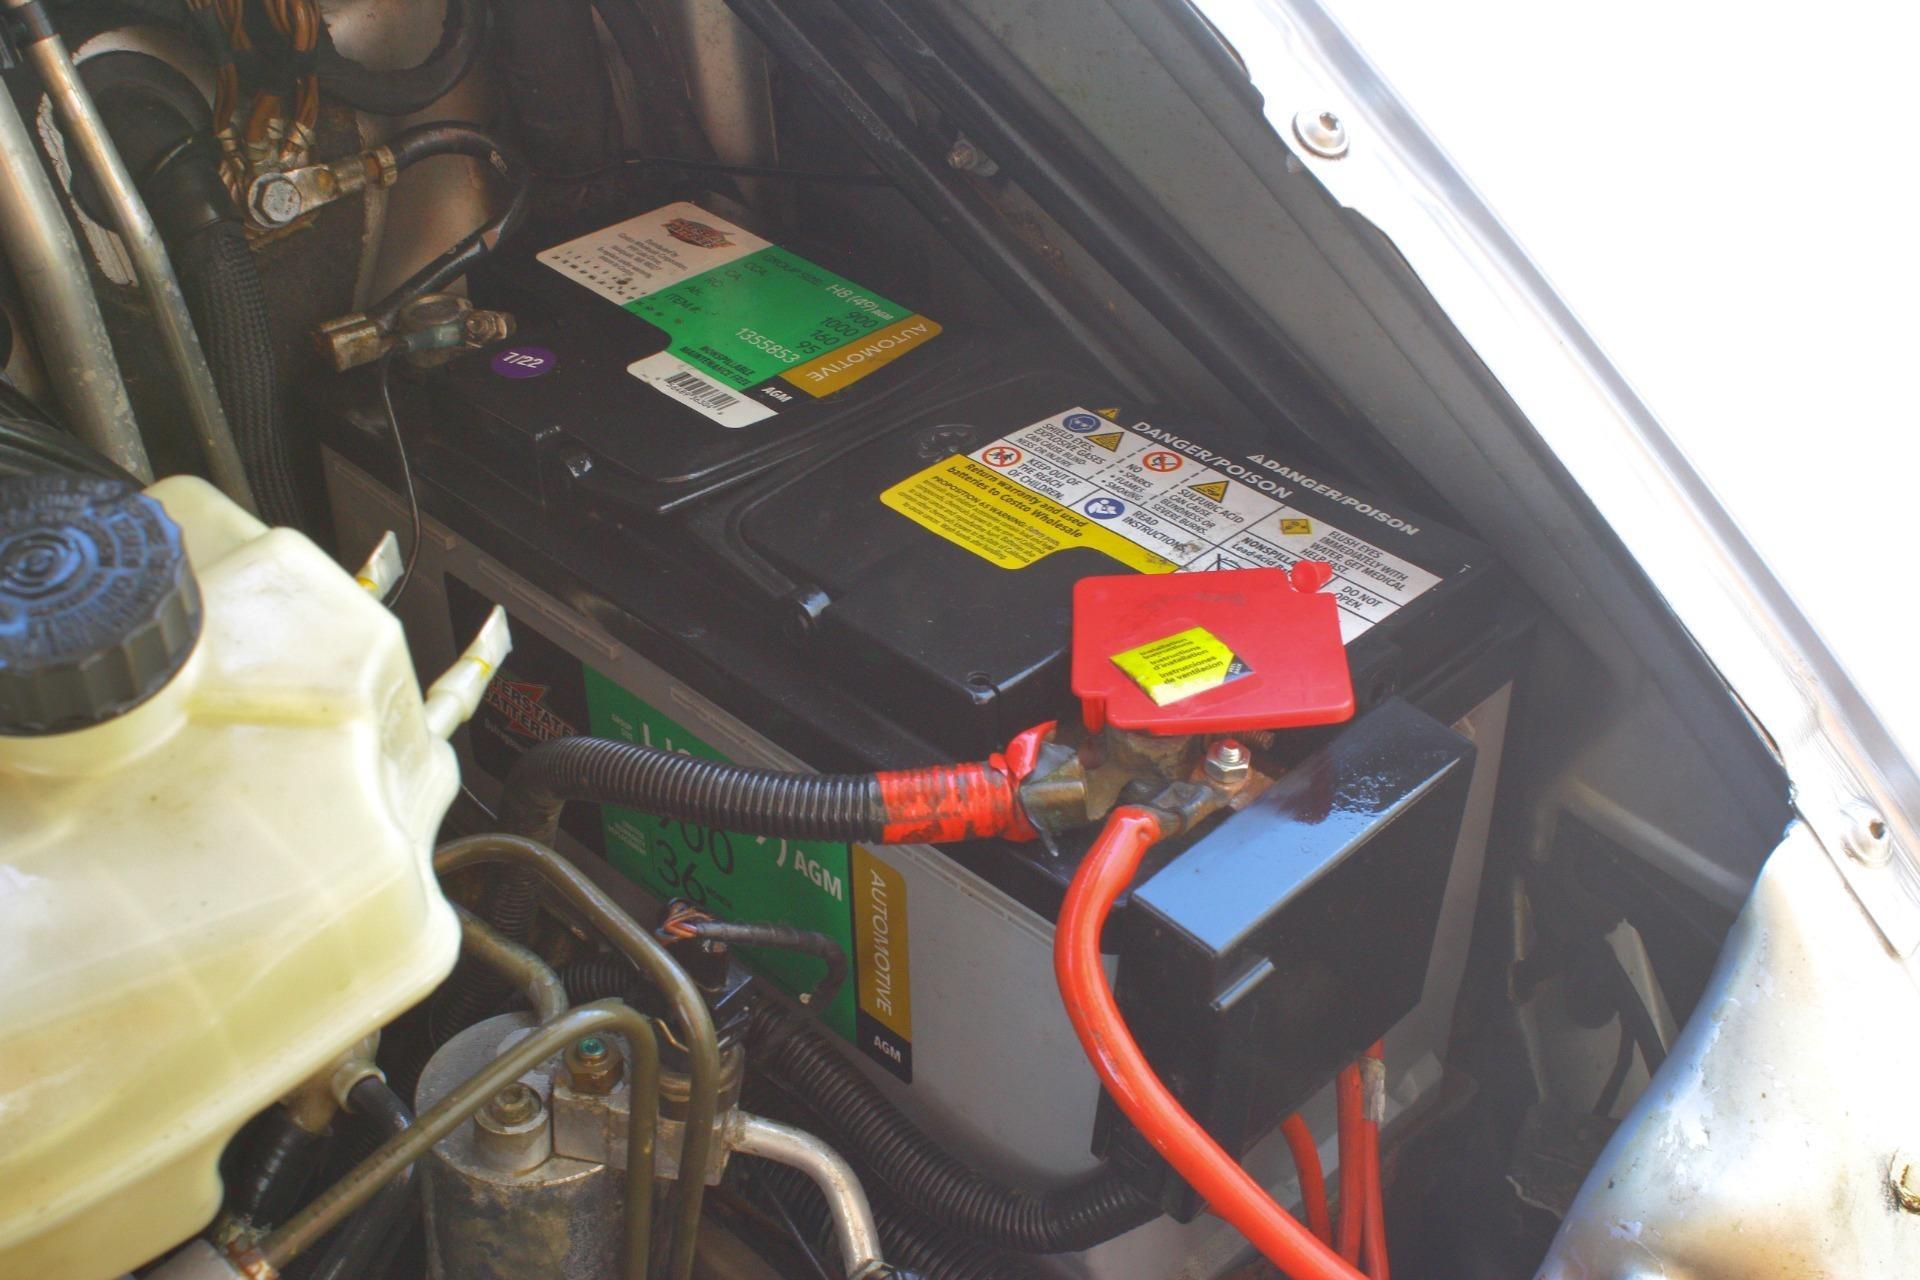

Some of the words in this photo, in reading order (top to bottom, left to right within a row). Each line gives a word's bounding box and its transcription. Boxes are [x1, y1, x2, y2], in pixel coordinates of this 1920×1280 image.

[826, 284, 853, 298] H8
[846, 294, 880, 312] (49)
[820, 317, 859, 337] 1000
[846, 311, 879, 328] 900
[736, 328, 801, 363] 1355853
[796, 340, 821, 354] 95
[811, 330, 840, 346] 160
[503, 352, 545, 369] 7/22
[700, 345, 756, 376] NONSPILLABLE
[806, 323, 928, 382] AUTOMOTIVE
[761, 386, 793, 403] AGM
[1025, 433, 1043, 444] CAN
[1040, 440, 1064, 455] CAUSE
[1042, 423, 1074, 440] SHIELD
[1016, 438, 1036, 450] NESS
[1034, 446, 1046, 455] OR
[1034, 428, 1077, 452] EXPLOSIVE
[1076, 449, 1107, 465] GASES
[1132, 421, 1294, 500] DANGER/POISON
[1017, 463, 1036, 475] THE
[1034, 472, 1063, 489] REACH
[1027, 458, 1052, 471] KEEP
[1049, 468, 1068, 480] OUT
[1066, 477, 1084, 487] OF
[1124, 471, 1154, 488] SPARKS
[1126, 463, 1144, 474] NO
[964, 463, 999, 483] Return
[998, 479, 1041, 507] warranty
[1039, 501, 1062, 516] and
[1060, 511, 1089, 528] used
[1007, 469, 1022, 478] OF
[1019, 474, 1065, 501] CHILDREN.
[1105, 480, 1144, 501] SMOKING
[1114, 475, 1147, 493] FLAMES
[1264, 459, 1420, 536] DANGER/POISON
[932, 475, 980, 504] PROPOSITION
[977, 499, 991, 510] 65
[987, 503, 1027, 529] WARNING:
[947, 467, 992, 490] batteries
[989, 486, 1002, 497] to
[999, 494, 1033, 513] Costco
[1031, 508, 1084, 538] Wholesale
[1160, 498, 1205, 523] BLINDNESS
[1201, 519, 1216, 529] OR
[1169, 494, 1187, 505] CAN
[1184, 503, 1213, 518] CAUSE
[1178, 488, 1224, 513] SULFURIC
[1220, 510, 1245, 524] ACID
[1132, 510, 1159, 526] READ
[1151, 503, 1182, 521] SEVERE
[1179, 518, 1208, 535] BURNS.
[1231, 543, 1276, 569] Lead-Acid
[1241, 536, 1298, 567] NONSPILLA
[1301, 548, 1329, 563] HELP
[1328, 530, 1360, 549] FLUSH
[1356, 544, 1384, 559] EYES
[1310, 542, 1345, 562] WATER.
[1344, 558, 1364, 571] GET
[1359, 567, 1406, 592] MEDICAL
[1320, 537, 1383, 571] IMMEDIATELY
[1381, 565, 1409, 582] WITH
[1335, 592, 1362, 611] OPEN.
[1341, 585, 1358, 597] DO
[1357, 593, 1384, 608] NOT
[794, 850, 843, 901] AGM
[870, 868, 892, 1017] AUTOMOTIVE
[874, 1035, 902, 1063] AGM
